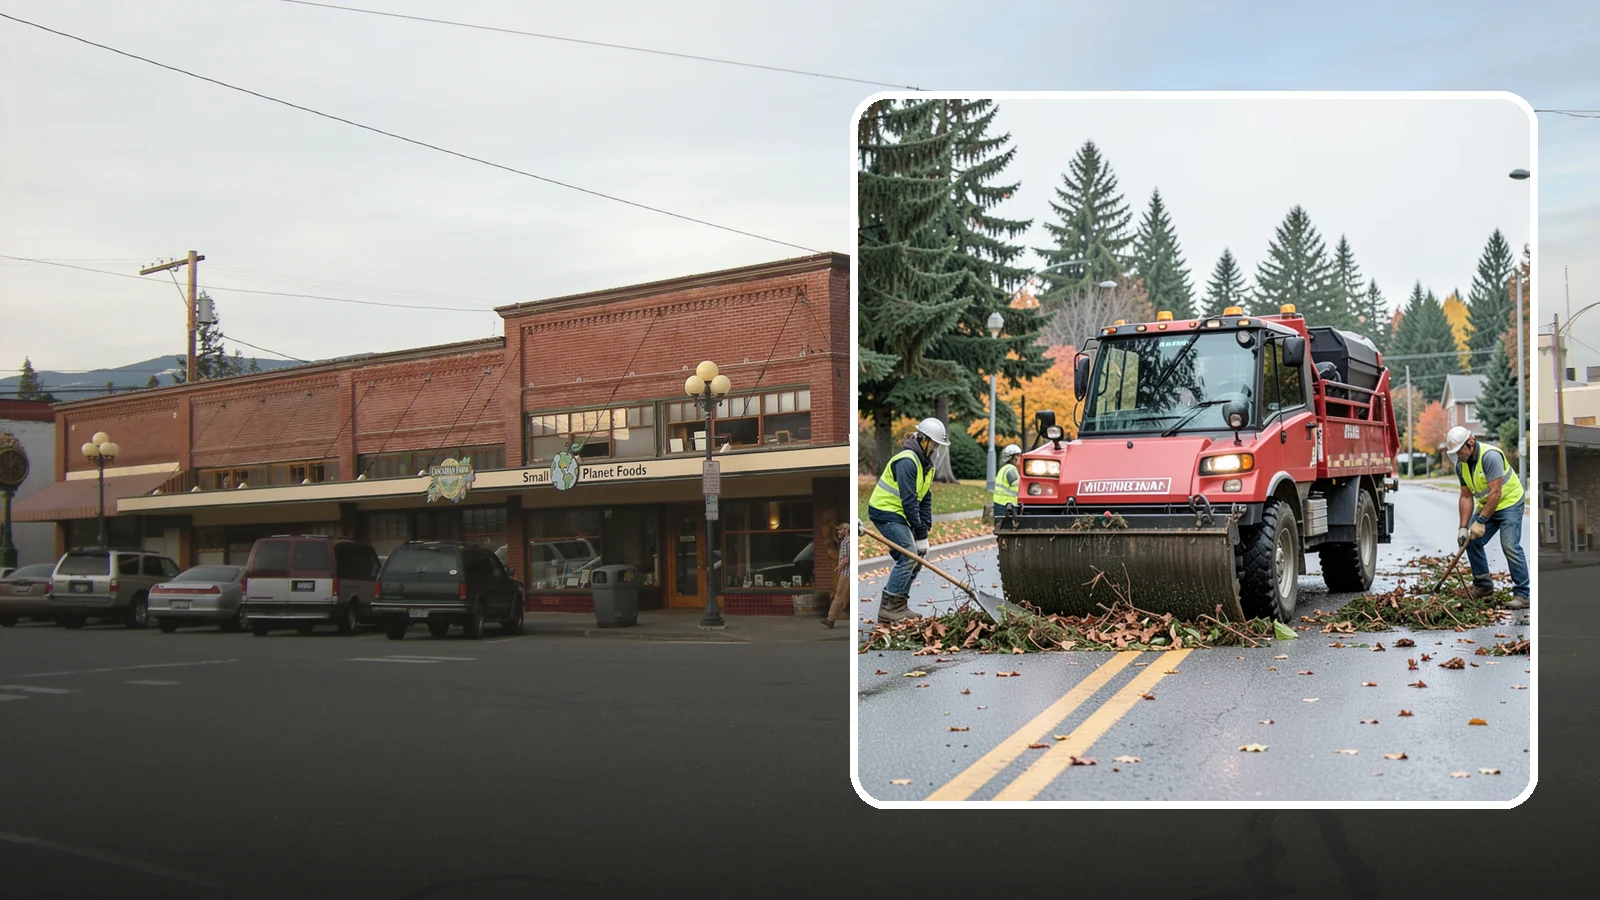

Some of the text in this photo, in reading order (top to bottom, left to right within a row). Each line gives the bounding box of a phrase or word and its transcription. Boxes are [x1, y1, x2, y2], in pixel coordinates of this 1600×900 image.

[523, 464, 647, 483] Small Planet Foods
